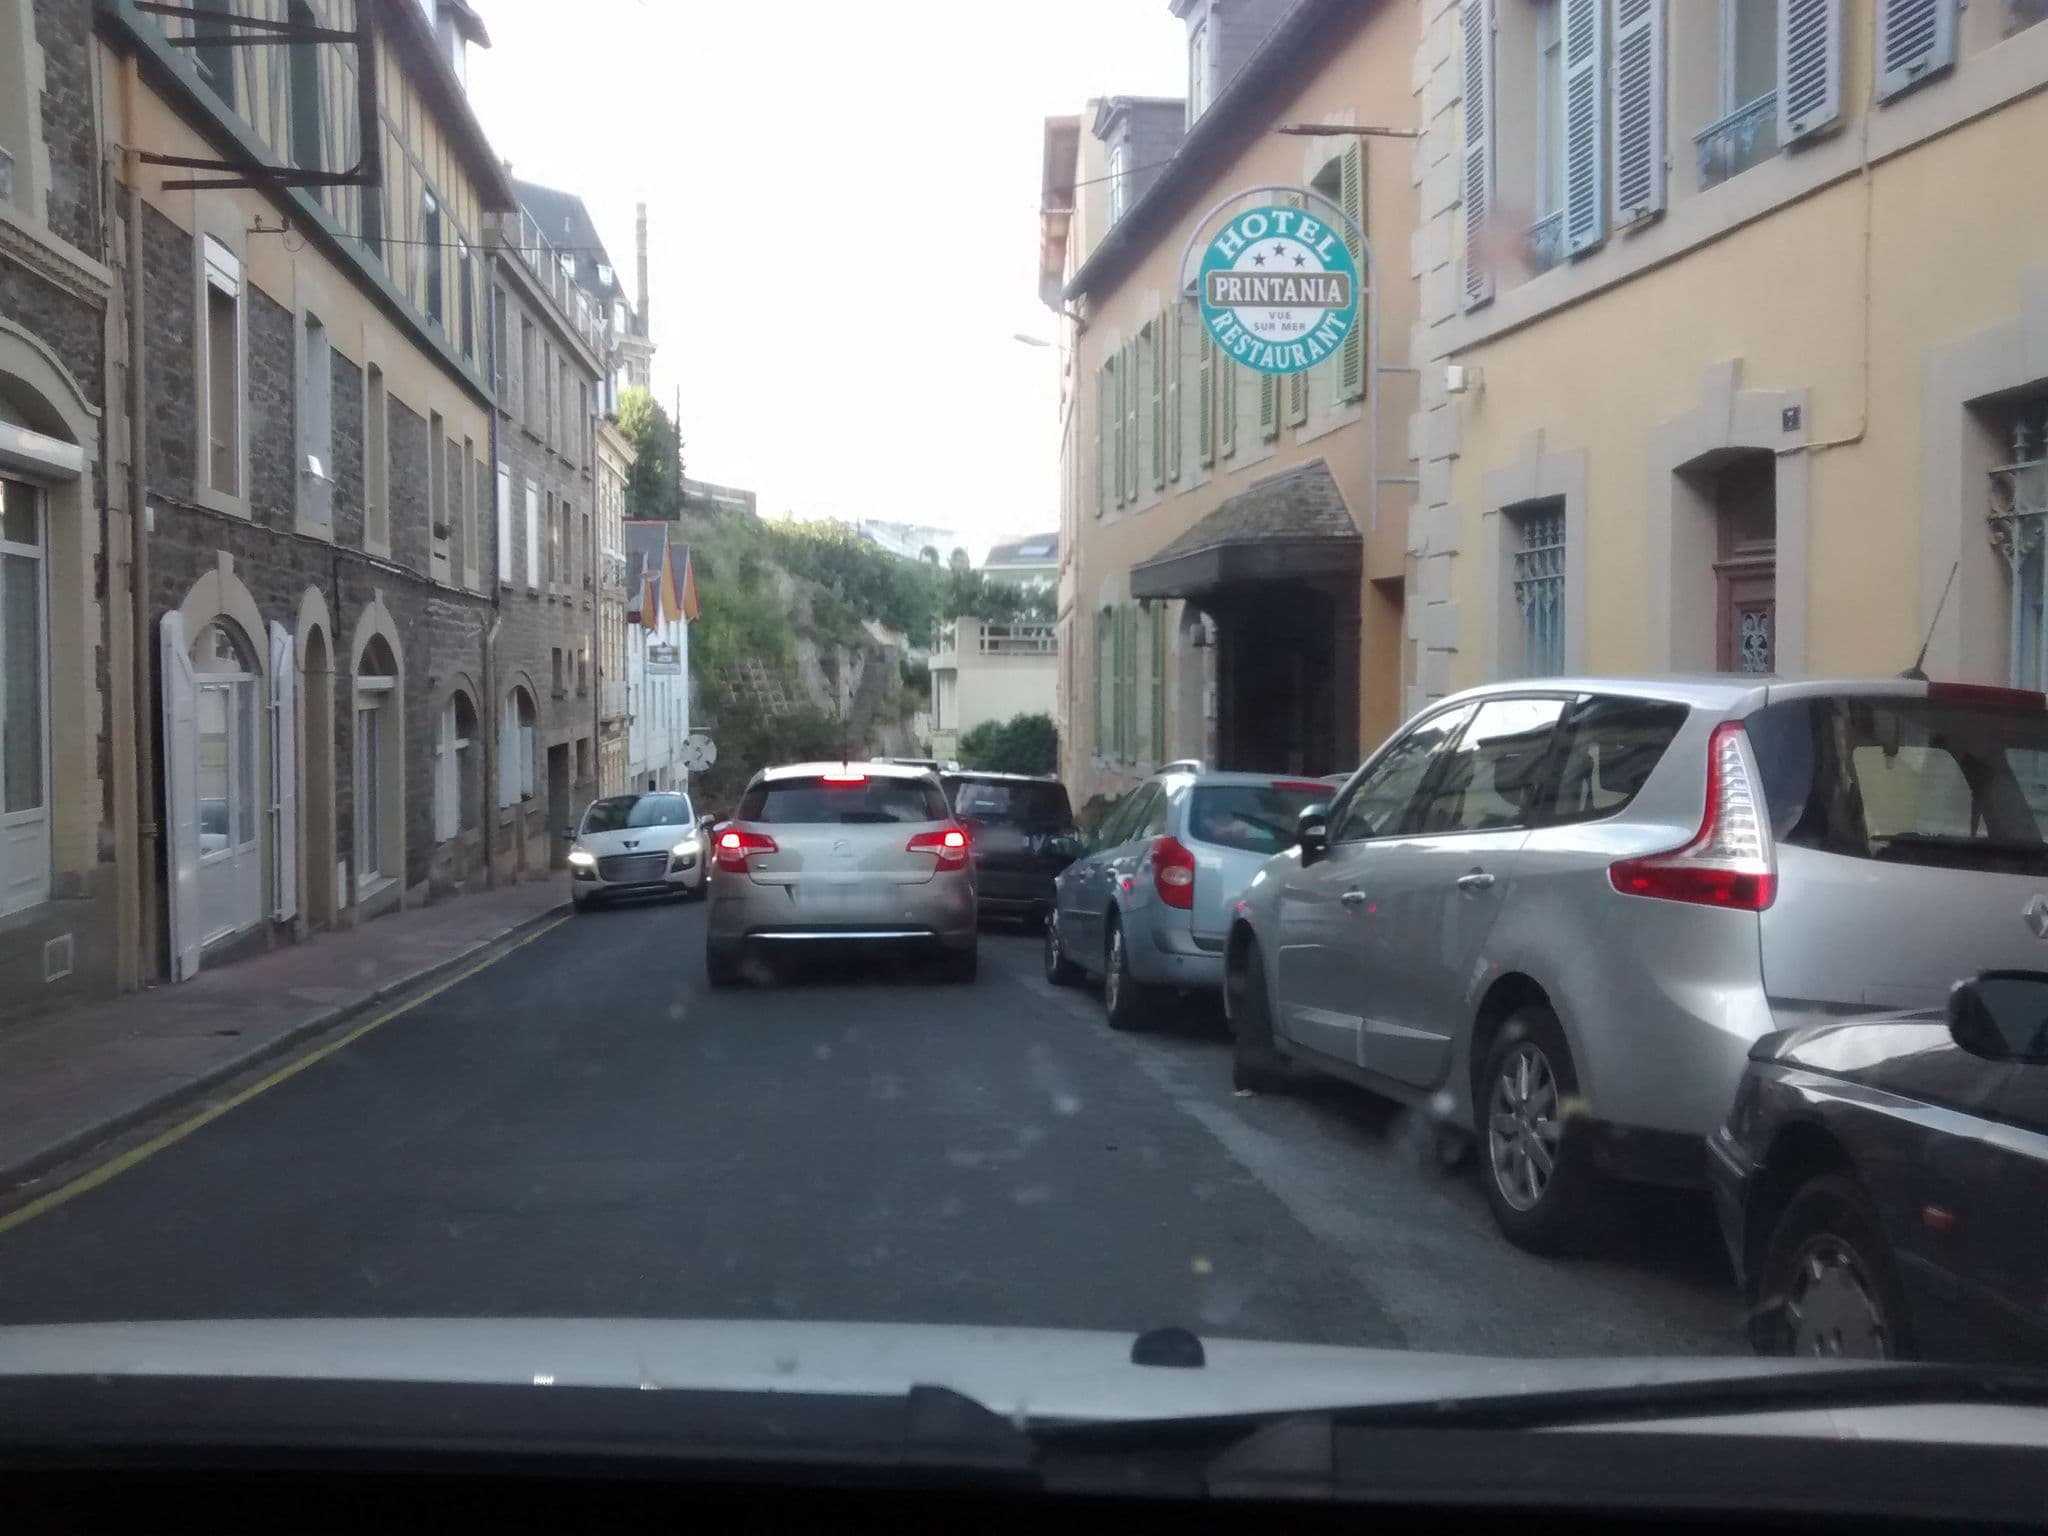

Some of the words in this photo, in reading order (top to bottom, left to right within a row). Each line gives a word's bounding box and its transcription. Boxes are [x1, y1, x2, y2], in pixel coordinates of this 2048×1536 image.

[1214, 210, 1336, 262] HOTEL
[1215, 276, 1343, 302] PRINTANIA
[1254, 322, 1276, 331] SUR
[1281, 322, 1306, 331] MER
[1268, 311, 1291, 320] VUE
[1211, 311, 1348, 369] RESTAURANT
